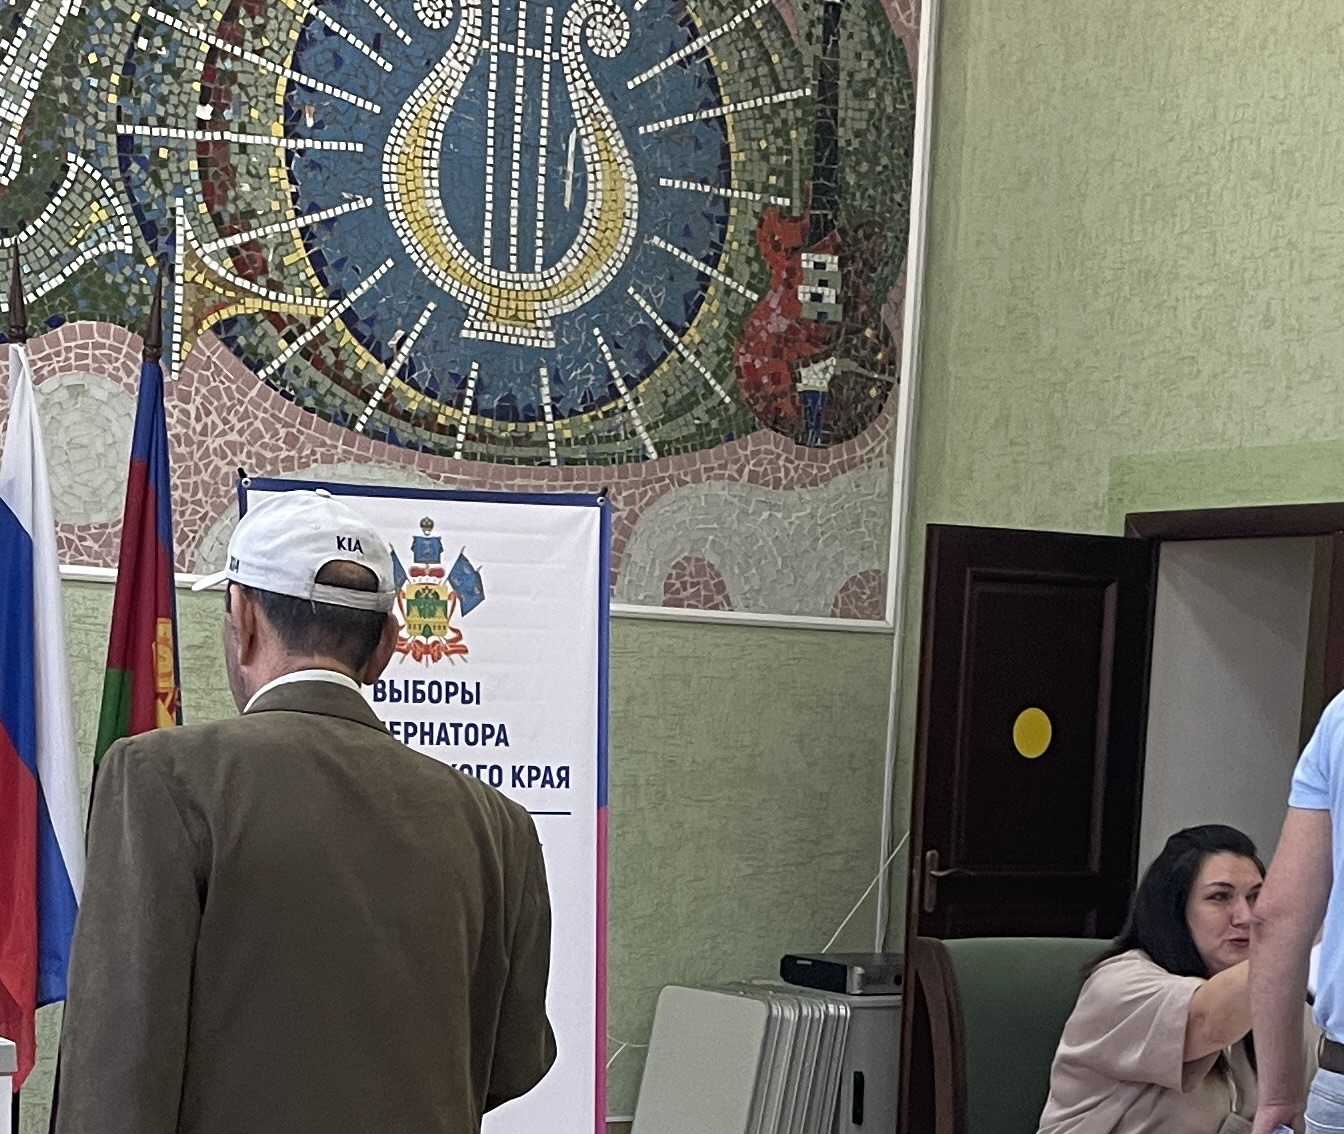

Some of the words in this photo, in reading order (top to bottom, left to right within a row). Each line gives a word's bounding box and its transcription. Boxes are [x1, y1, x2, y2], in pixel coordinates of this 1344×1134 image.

[336, 535, 364, 555] KIA
[373, 679, 481, 705] ВЫБОРЫ
[383, 721, 510, 747] ЕРНАТОРА
[511, 765, 570, 789] КРАЯ
